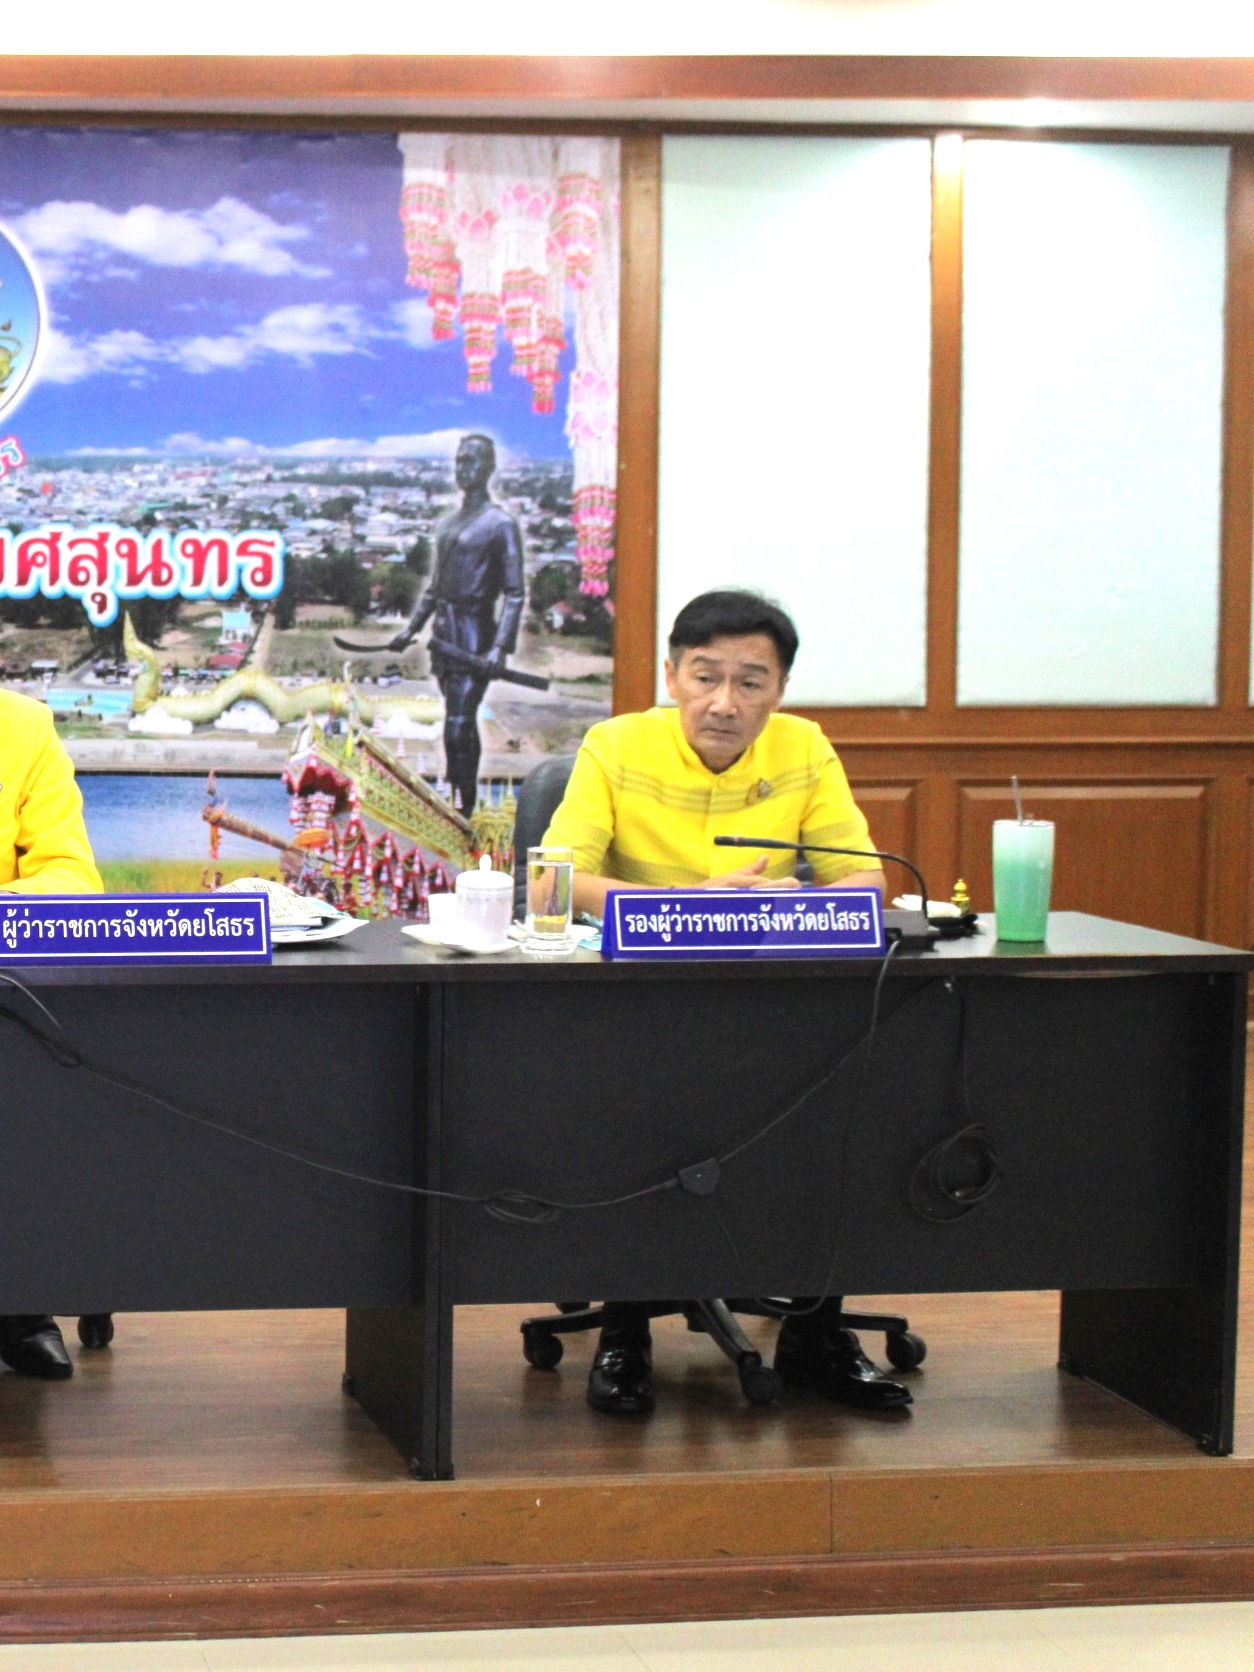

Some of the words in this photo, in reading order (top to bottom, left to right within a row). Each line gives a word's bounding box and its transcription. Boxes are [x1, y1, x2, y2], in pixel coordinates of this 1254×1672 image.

[2, 908, 255, 948] ผู้ว่าราชการจังหวัดยโสธร
[625, 903, 870, 942] รองผู้ว่าราชการจังหวัดยโสธร
